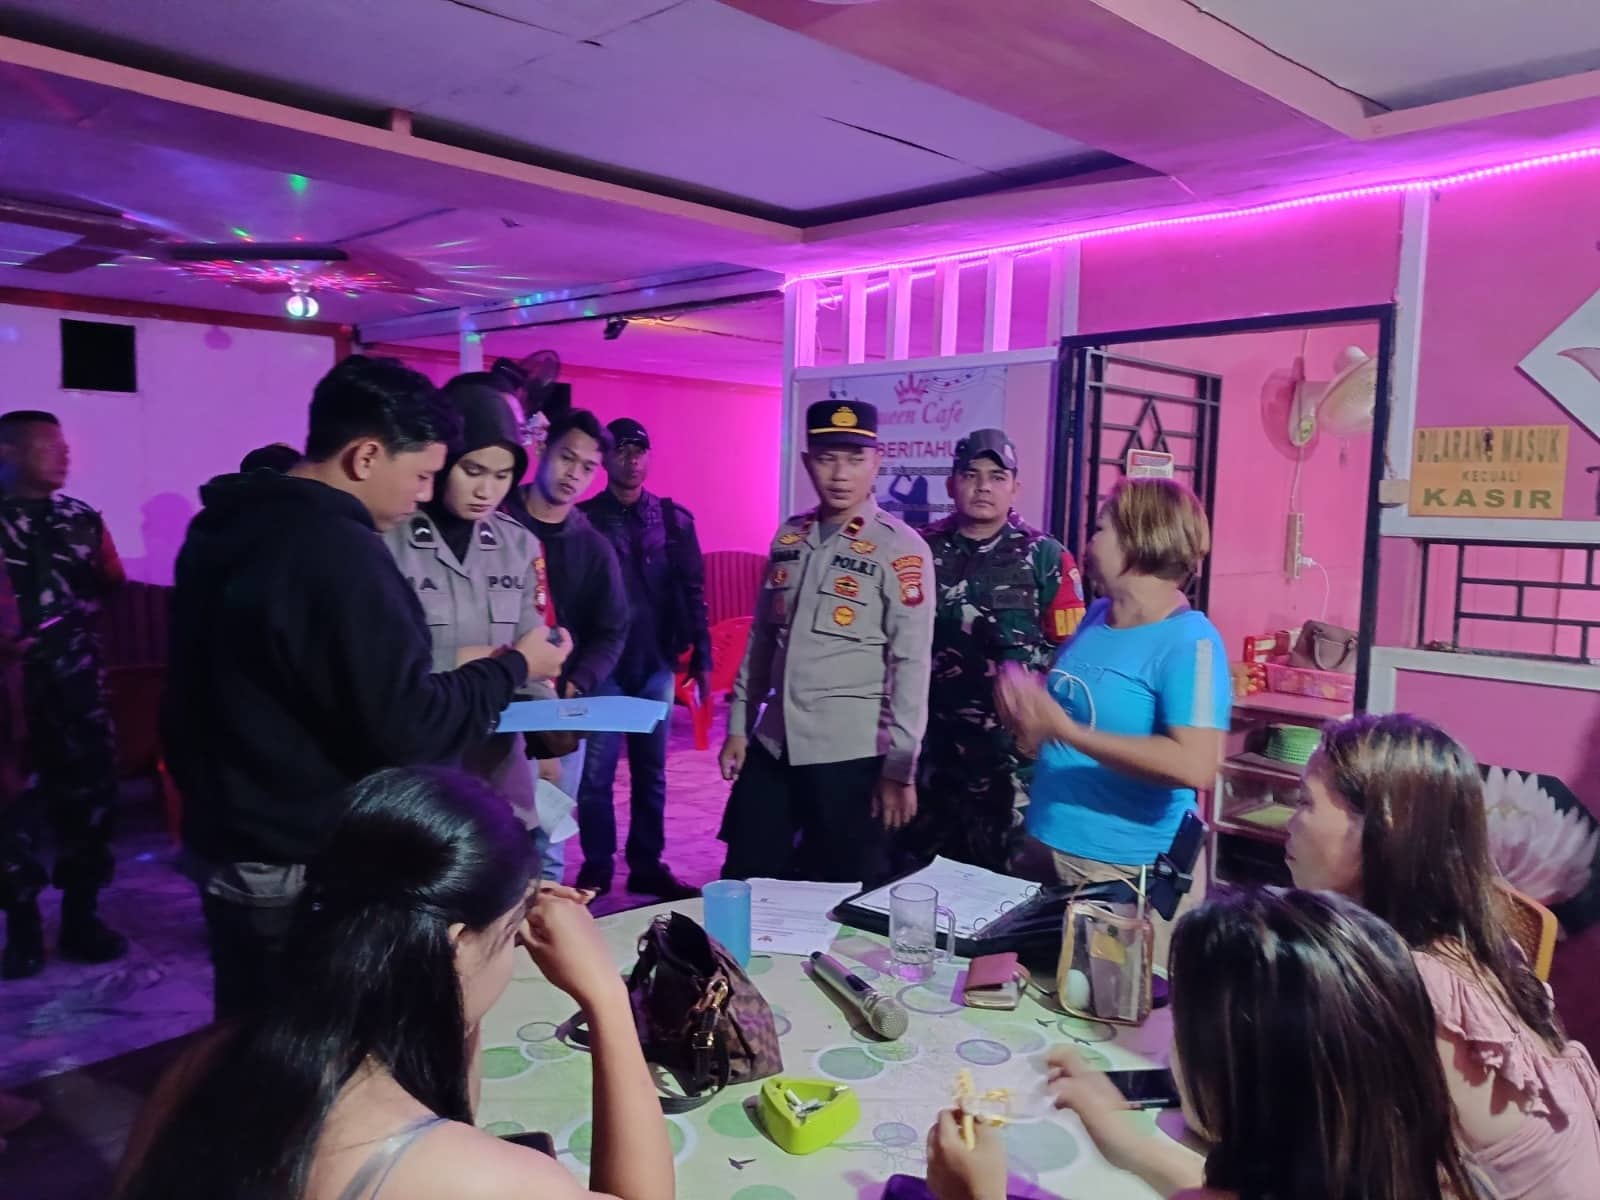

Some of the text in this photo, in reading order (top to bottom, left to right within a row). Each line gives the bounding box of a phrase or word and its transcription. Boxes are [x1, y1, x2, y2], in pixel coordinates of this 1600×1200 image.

[877, 400, 964, 432] ueen Cafe
[876, 440, 957, 458] BERITAHU
[1501, 428, 1560, 464] MASUK
[1462, 470, 1522, 483] KECUALI
[1423, 487, 1553, 510] KASIR
[831, 555, 877, 576] POLRI
[488, 575, 527, 589] POL
